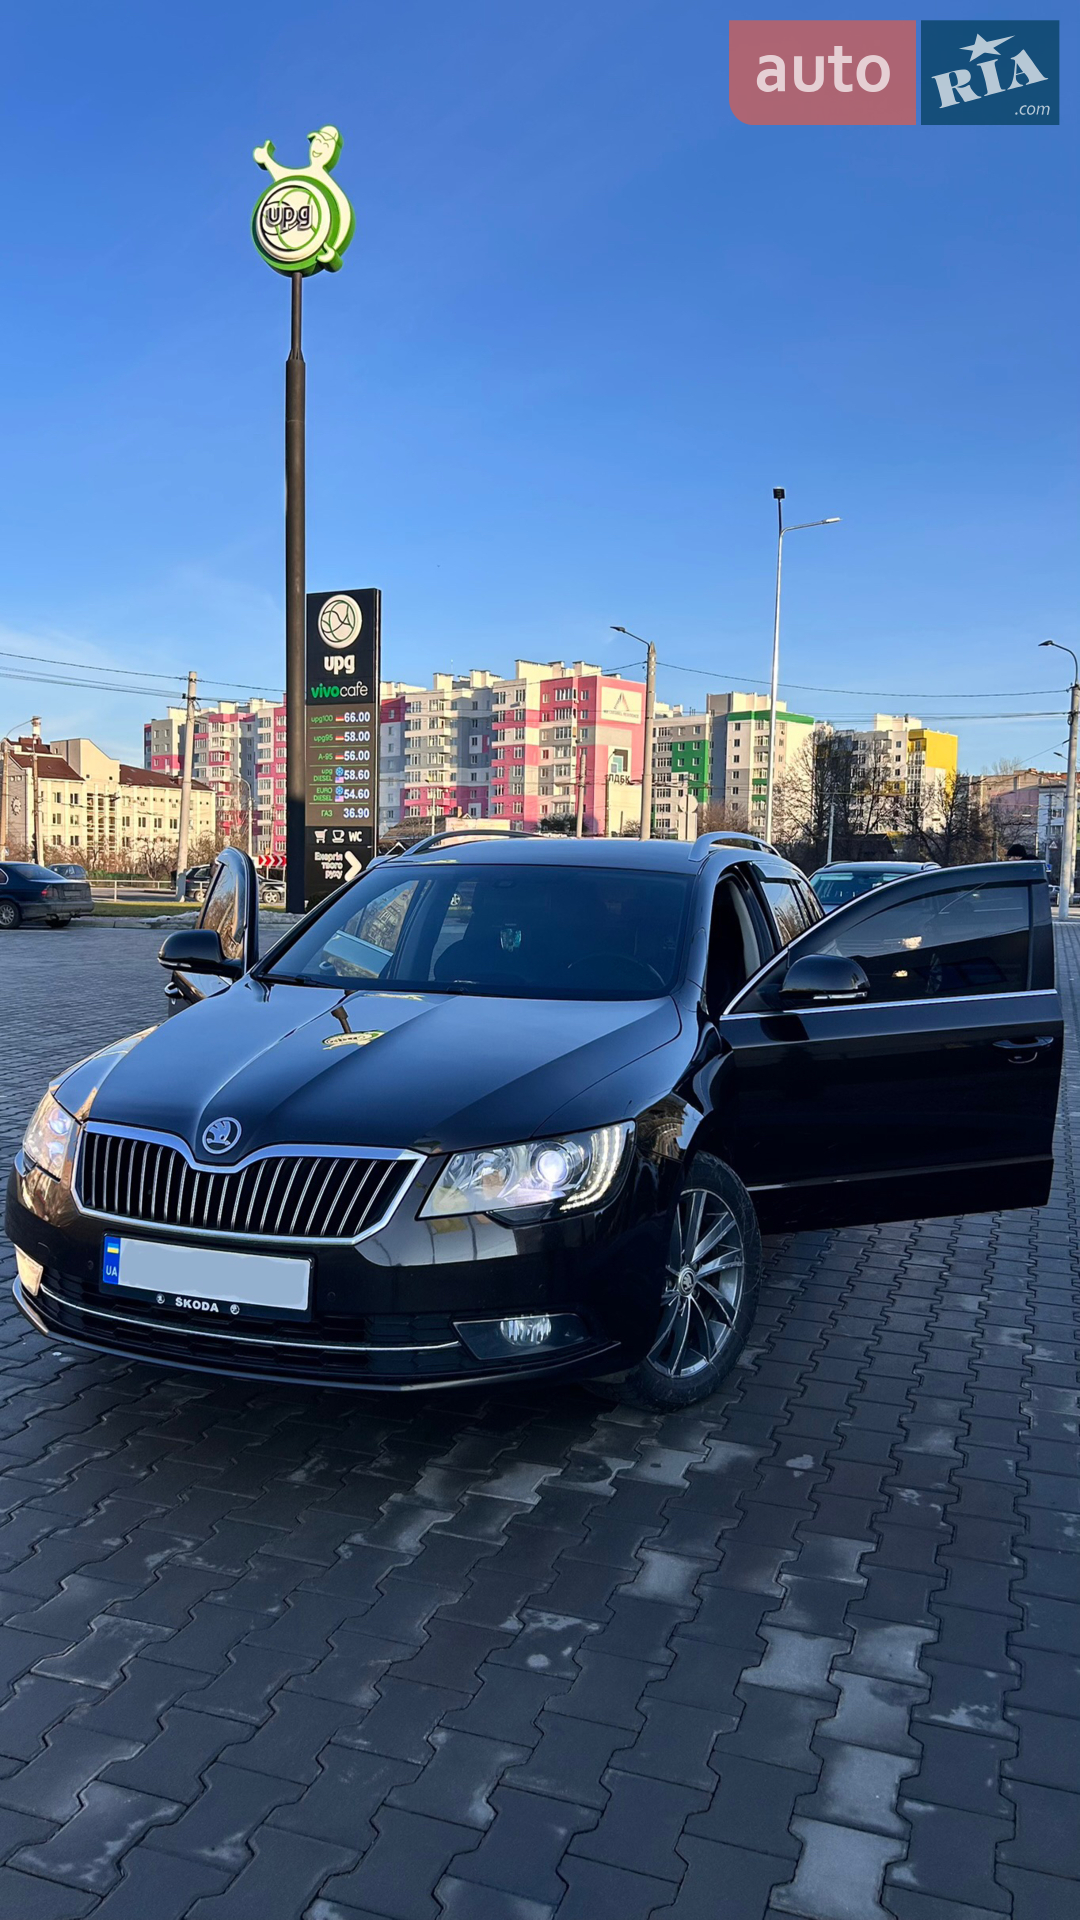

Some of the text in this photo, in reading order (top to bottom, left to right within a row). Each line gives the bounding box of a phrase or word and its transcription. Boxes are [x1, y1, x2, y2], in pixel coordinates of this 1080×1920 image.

[267, 204, 312, 230] upg
[323, 654, 356, 676] upg
[311, 680, 369, 699] vivocafe
[310, 711, 371, 724] upg100 66.00
[344, 730, 371, 742] 58.00
[344, 750, 371, 761] 56.00
[343, 769, 370, 781] 58.60
[343, 788, 370, 800] 54.60
[321, 807, 370, 819] ГАЗ 36.90
[348, 830, 363, 842] WC
[105, 1264, 118, 1278] UA
[175, 1296, 220, 1313] ŠKODA
